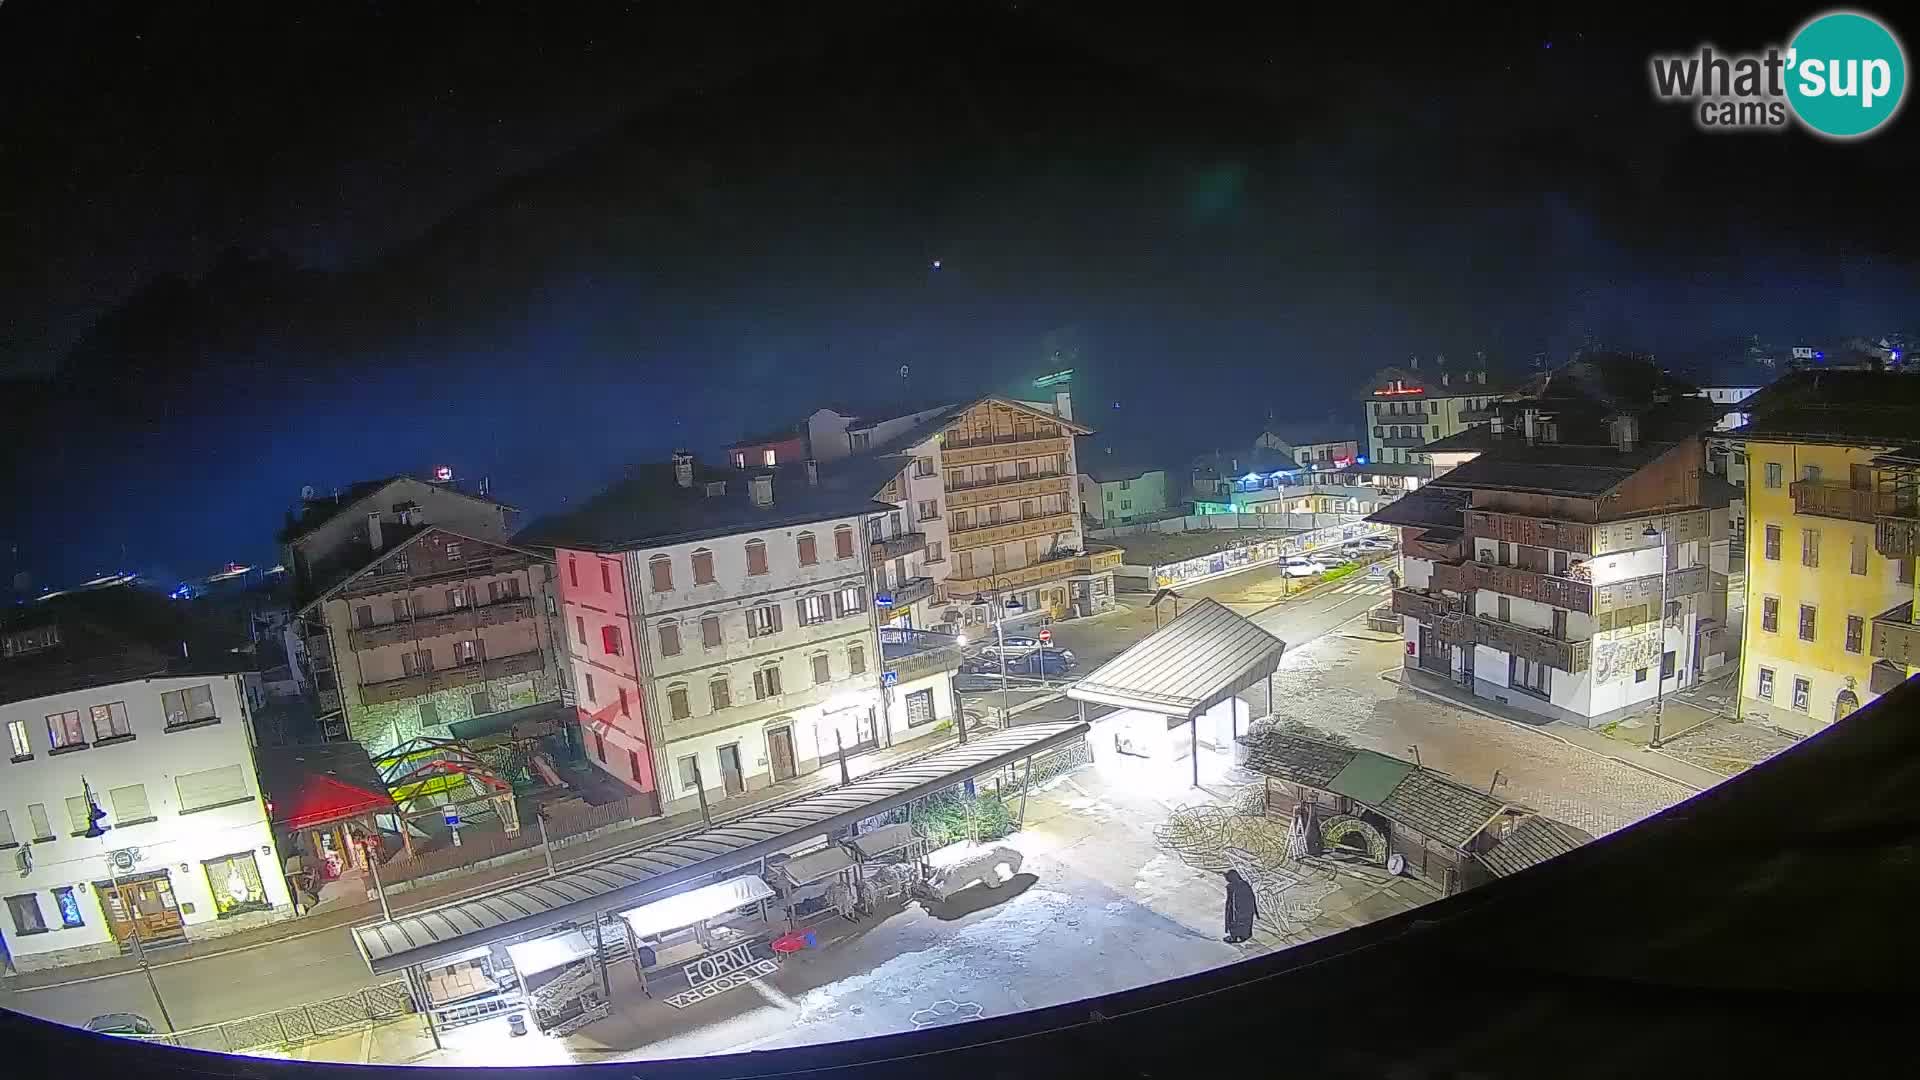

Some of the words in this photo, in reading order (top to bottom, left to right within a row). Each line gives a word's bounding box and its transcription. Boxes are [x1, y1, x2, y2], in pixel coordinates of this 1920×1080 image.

[683, 941, 757, 988] FORNI
[750, 960, 779, 980] DI
[664, 971, 752, 1008] SOPRA
